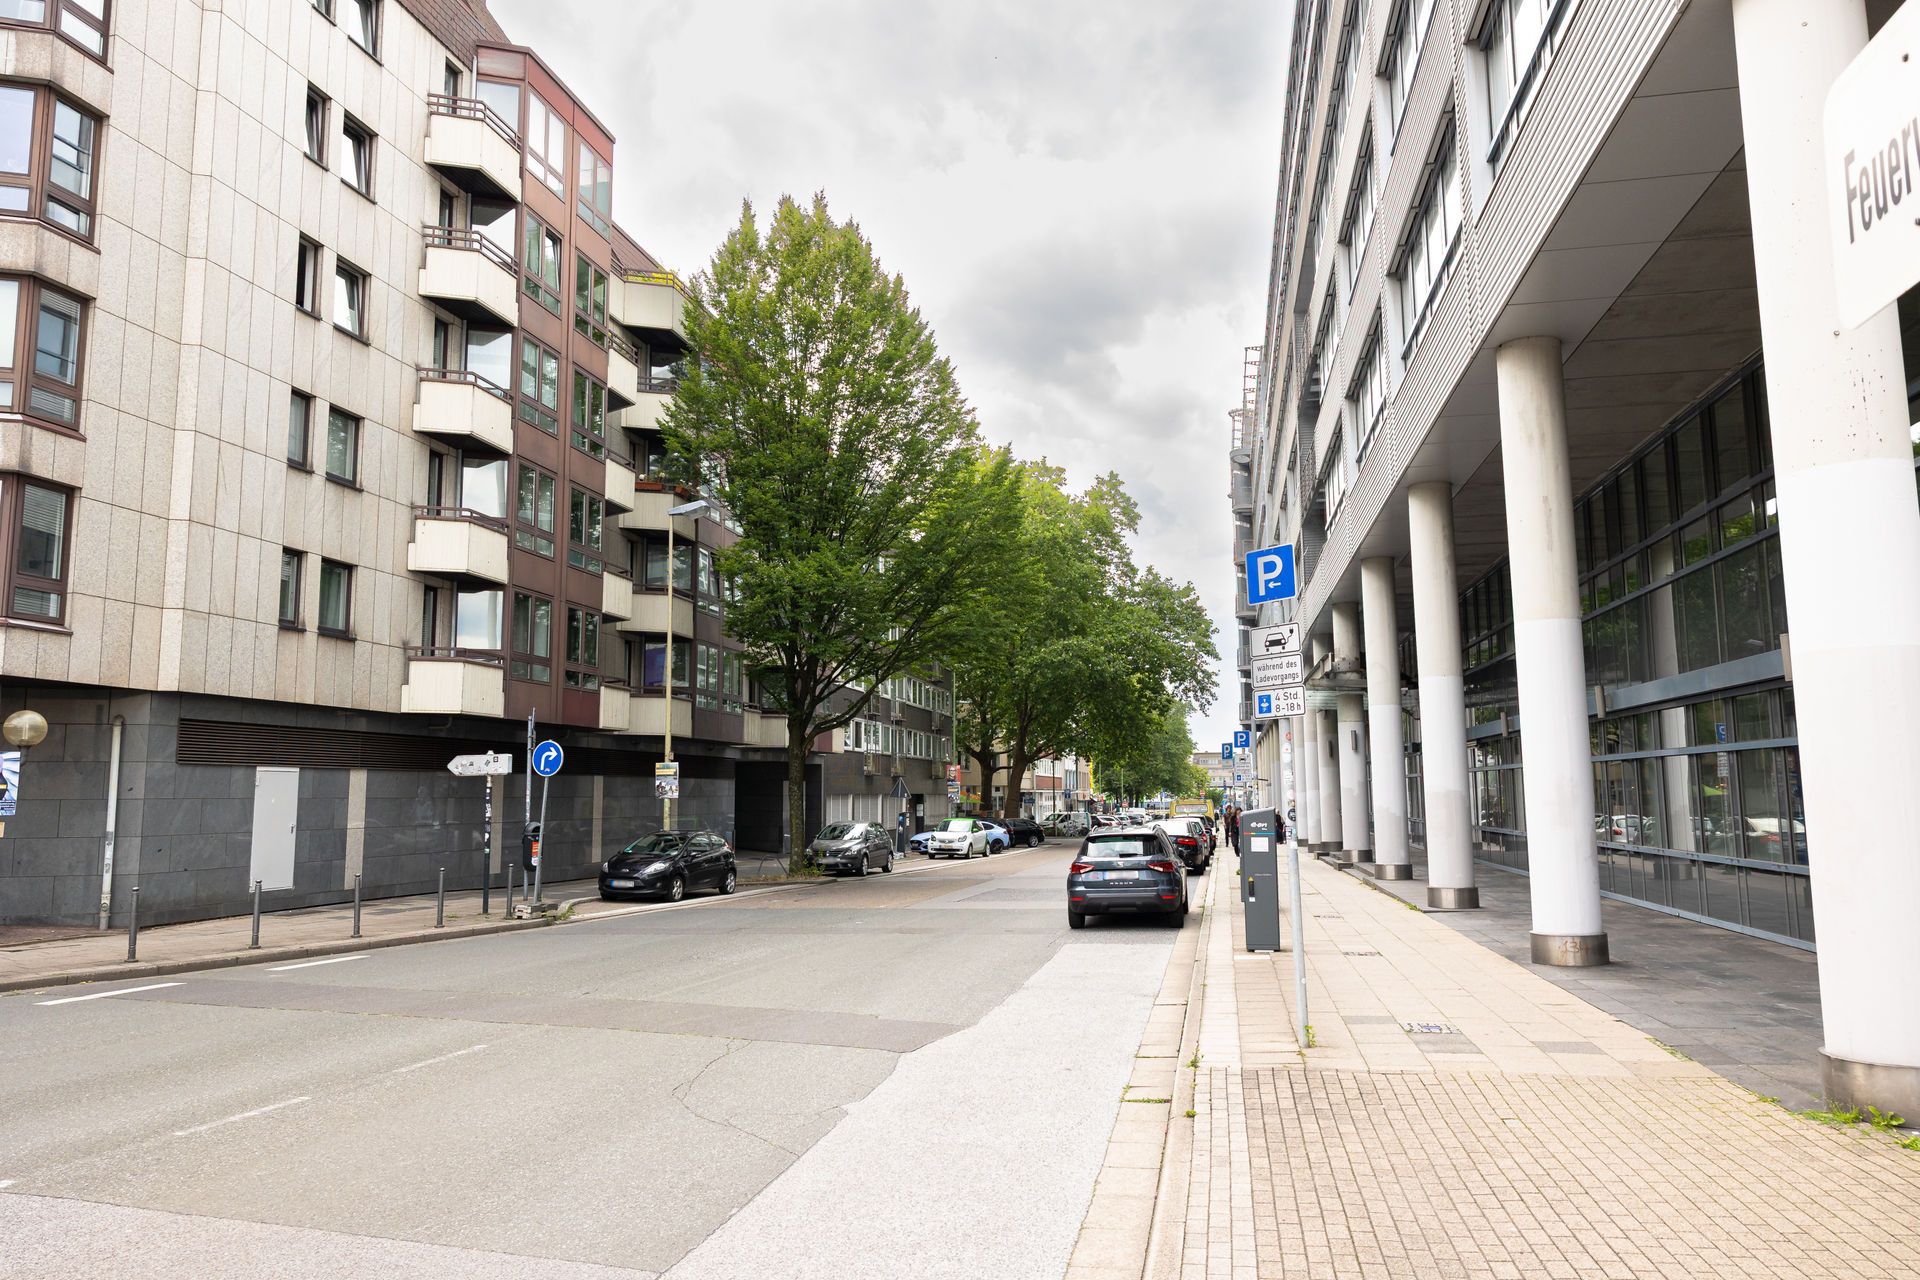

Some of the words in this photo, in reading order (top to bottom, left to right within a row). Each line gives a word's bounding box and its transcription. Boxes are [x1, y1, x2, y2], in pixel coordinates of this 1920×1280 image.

[1843, 116, 1920, 245] Feuer
[1256, 554, 1283, 597] P
[1256, 661, 1283, 672] während
[1286, 660, 1297, 669] des
[1255, 672, 1299, 684] Ladevorgangs
[1275, 692, 1280, 701] 4
[1283, 691, 1301, 701] Std.
[1275, 702, 1295, 713] 8-18
[1296, 702, 1302, 710] h
[1237, 732, 1247, 747] P
[1223, 744, 1231, 758] P
